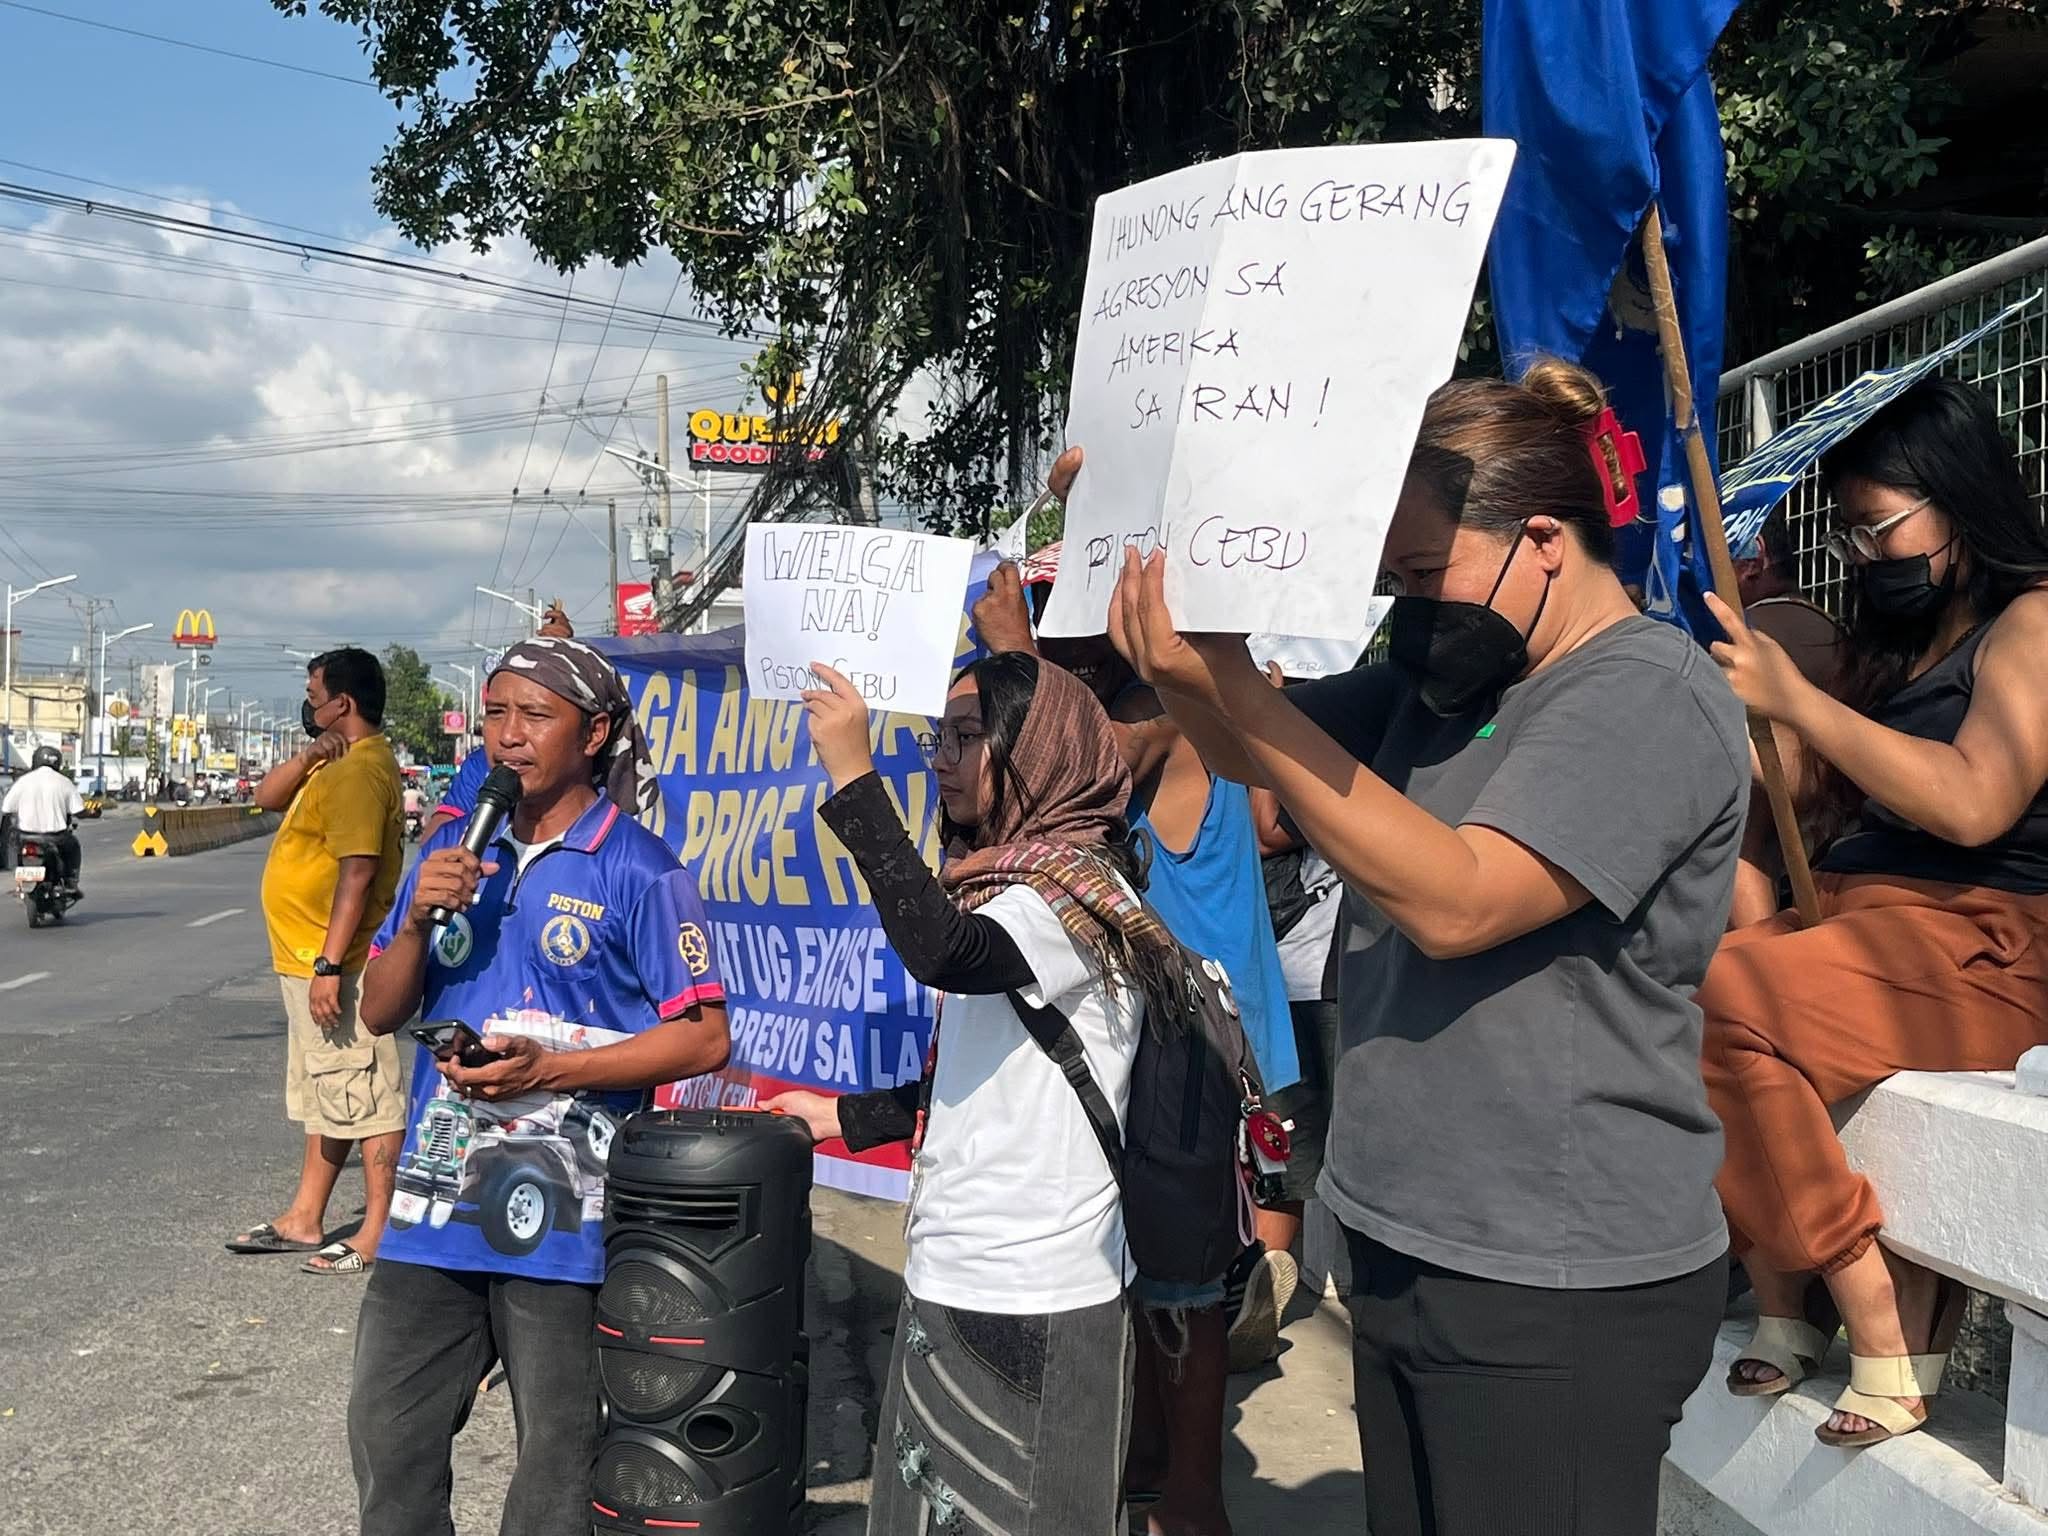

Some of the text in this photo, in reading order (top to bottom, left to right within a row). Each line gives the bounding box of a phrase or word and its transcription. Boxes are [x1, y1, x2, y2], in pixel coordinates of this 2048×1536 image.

[1107, 180, 1471, 262] IHUNONG ANG GERANG
[1092, 261, 1287, 326] AGRESYON SA
[1107, 328, 1240, 382] AMERIKA
[689, 408, 841, 446] QUE
[1130, 388, 1162, 429] SA
[764, 530, 925, 592] WELGA
[1189, 515, 1308, 571] CEBU
[800, 588, 890, 642] NA!
[621, 670, 697, 776] GA
[706, 664, 804, 774] ANG
[679, 782, 811, 906] PRICE
[547, 892, 606, 921] PISTON
[743, 924, 794, 1002] UG
[793, 926, 888, 1012] EXCISE
[730, 1007, 934, 1090] PRESYO SA LA
